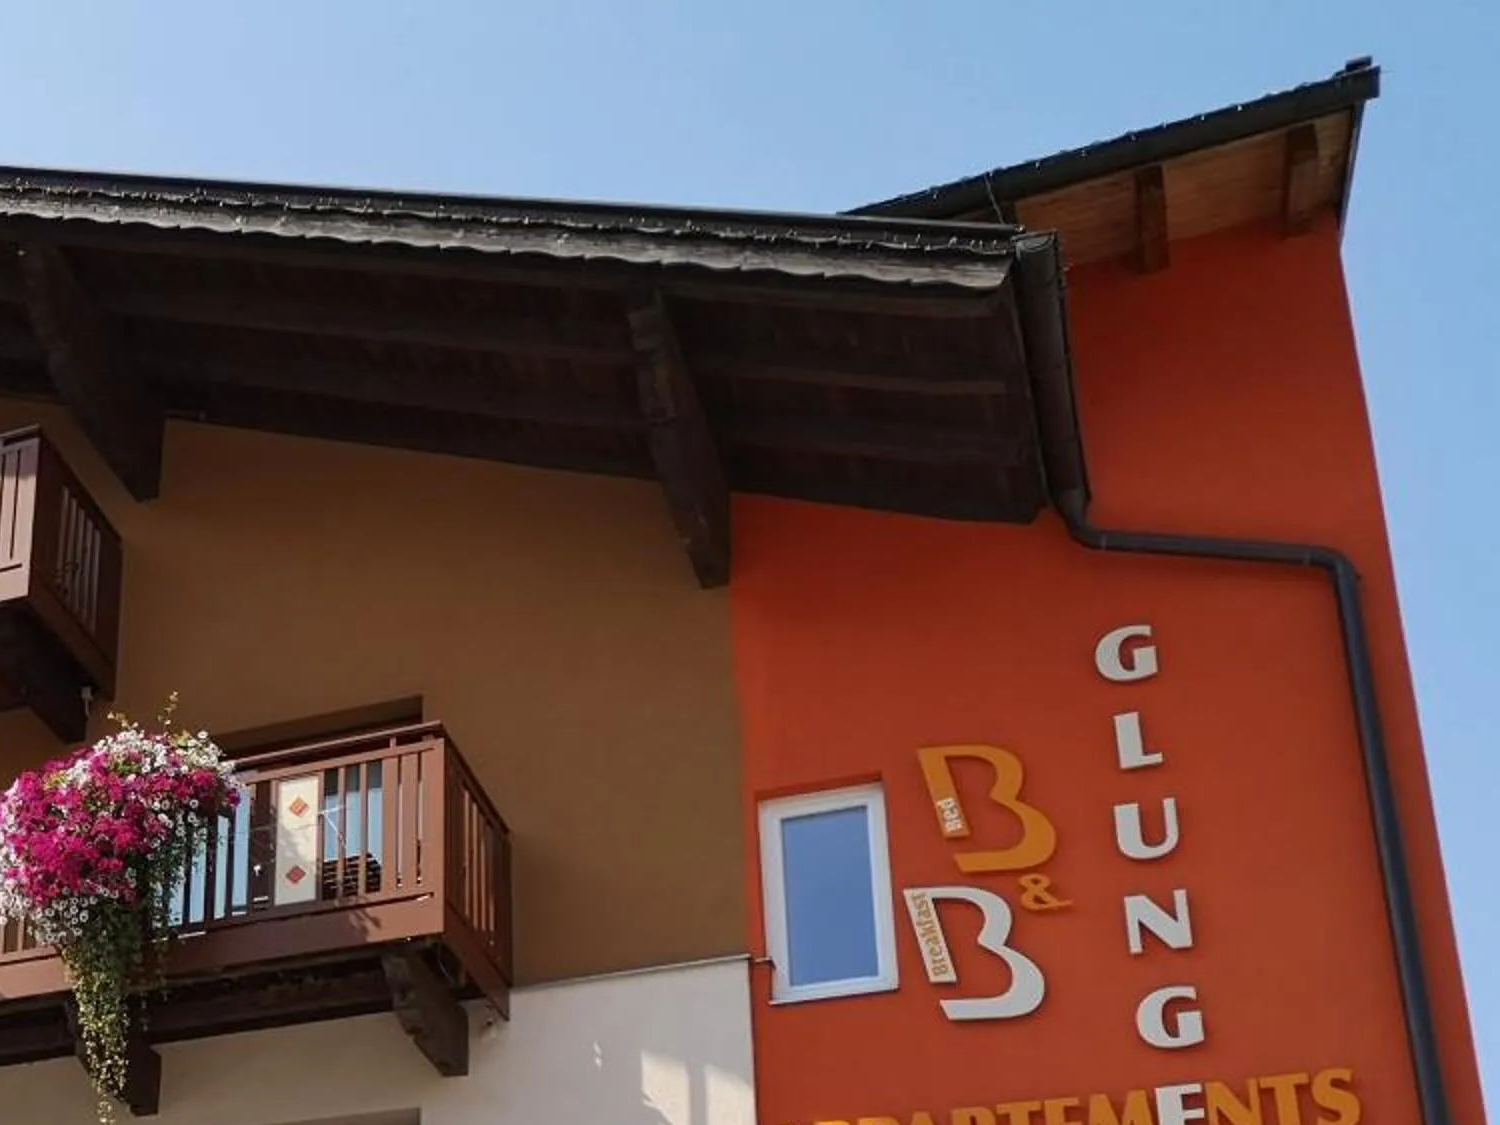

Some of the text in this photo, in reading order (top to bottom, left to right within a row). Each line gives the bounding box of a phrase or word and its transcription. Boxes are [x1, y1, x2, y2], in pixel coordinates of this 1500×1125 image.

[902, 744, 1075, 1021] B & B
[911, 891, 949, 977] Breakfast
